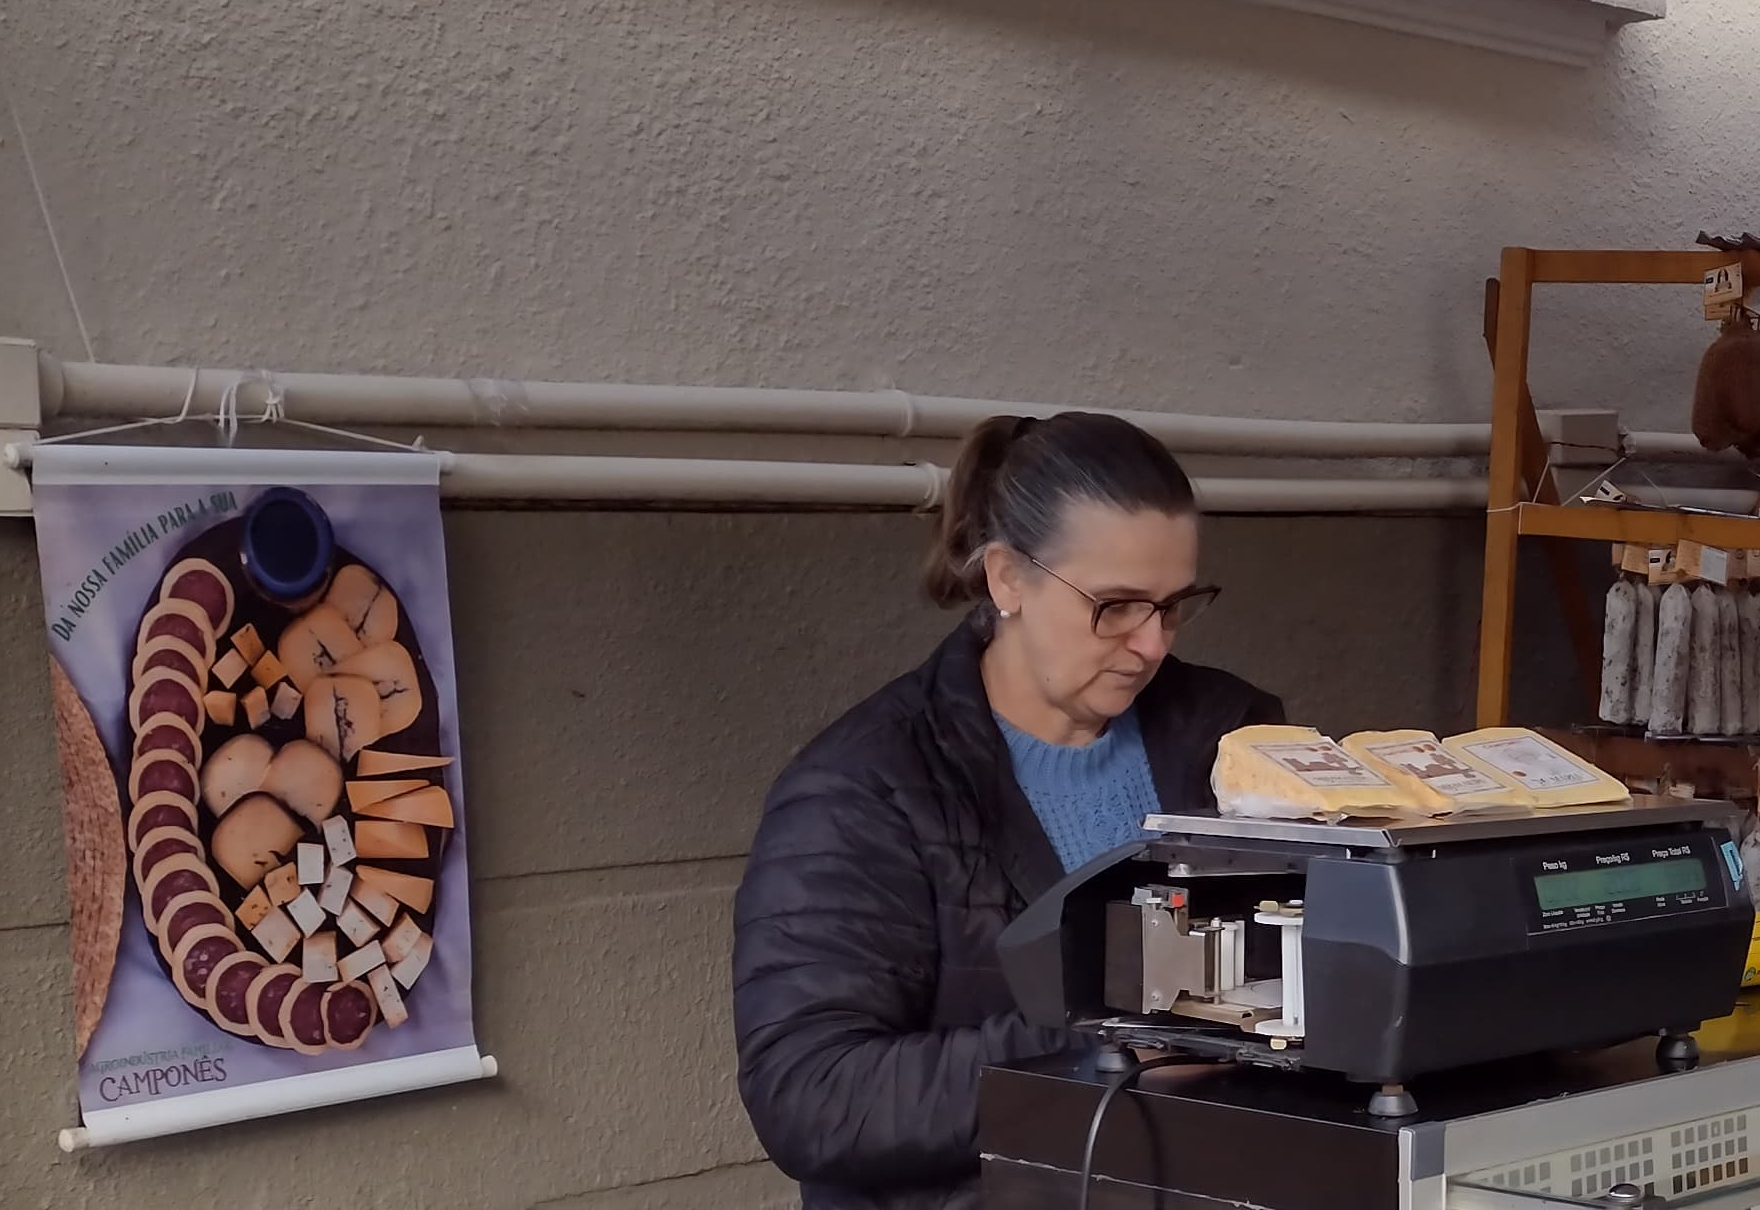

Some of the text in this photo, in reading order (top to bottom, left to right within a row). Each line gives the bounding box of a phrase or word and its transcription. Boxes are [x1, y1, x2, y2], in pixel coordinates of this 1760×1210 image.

[51, 491, 238, 642] DA NOSSA FAMÍLIA PARA A SUA
[100, 1055, 228, 1102] CAMPONÊS
